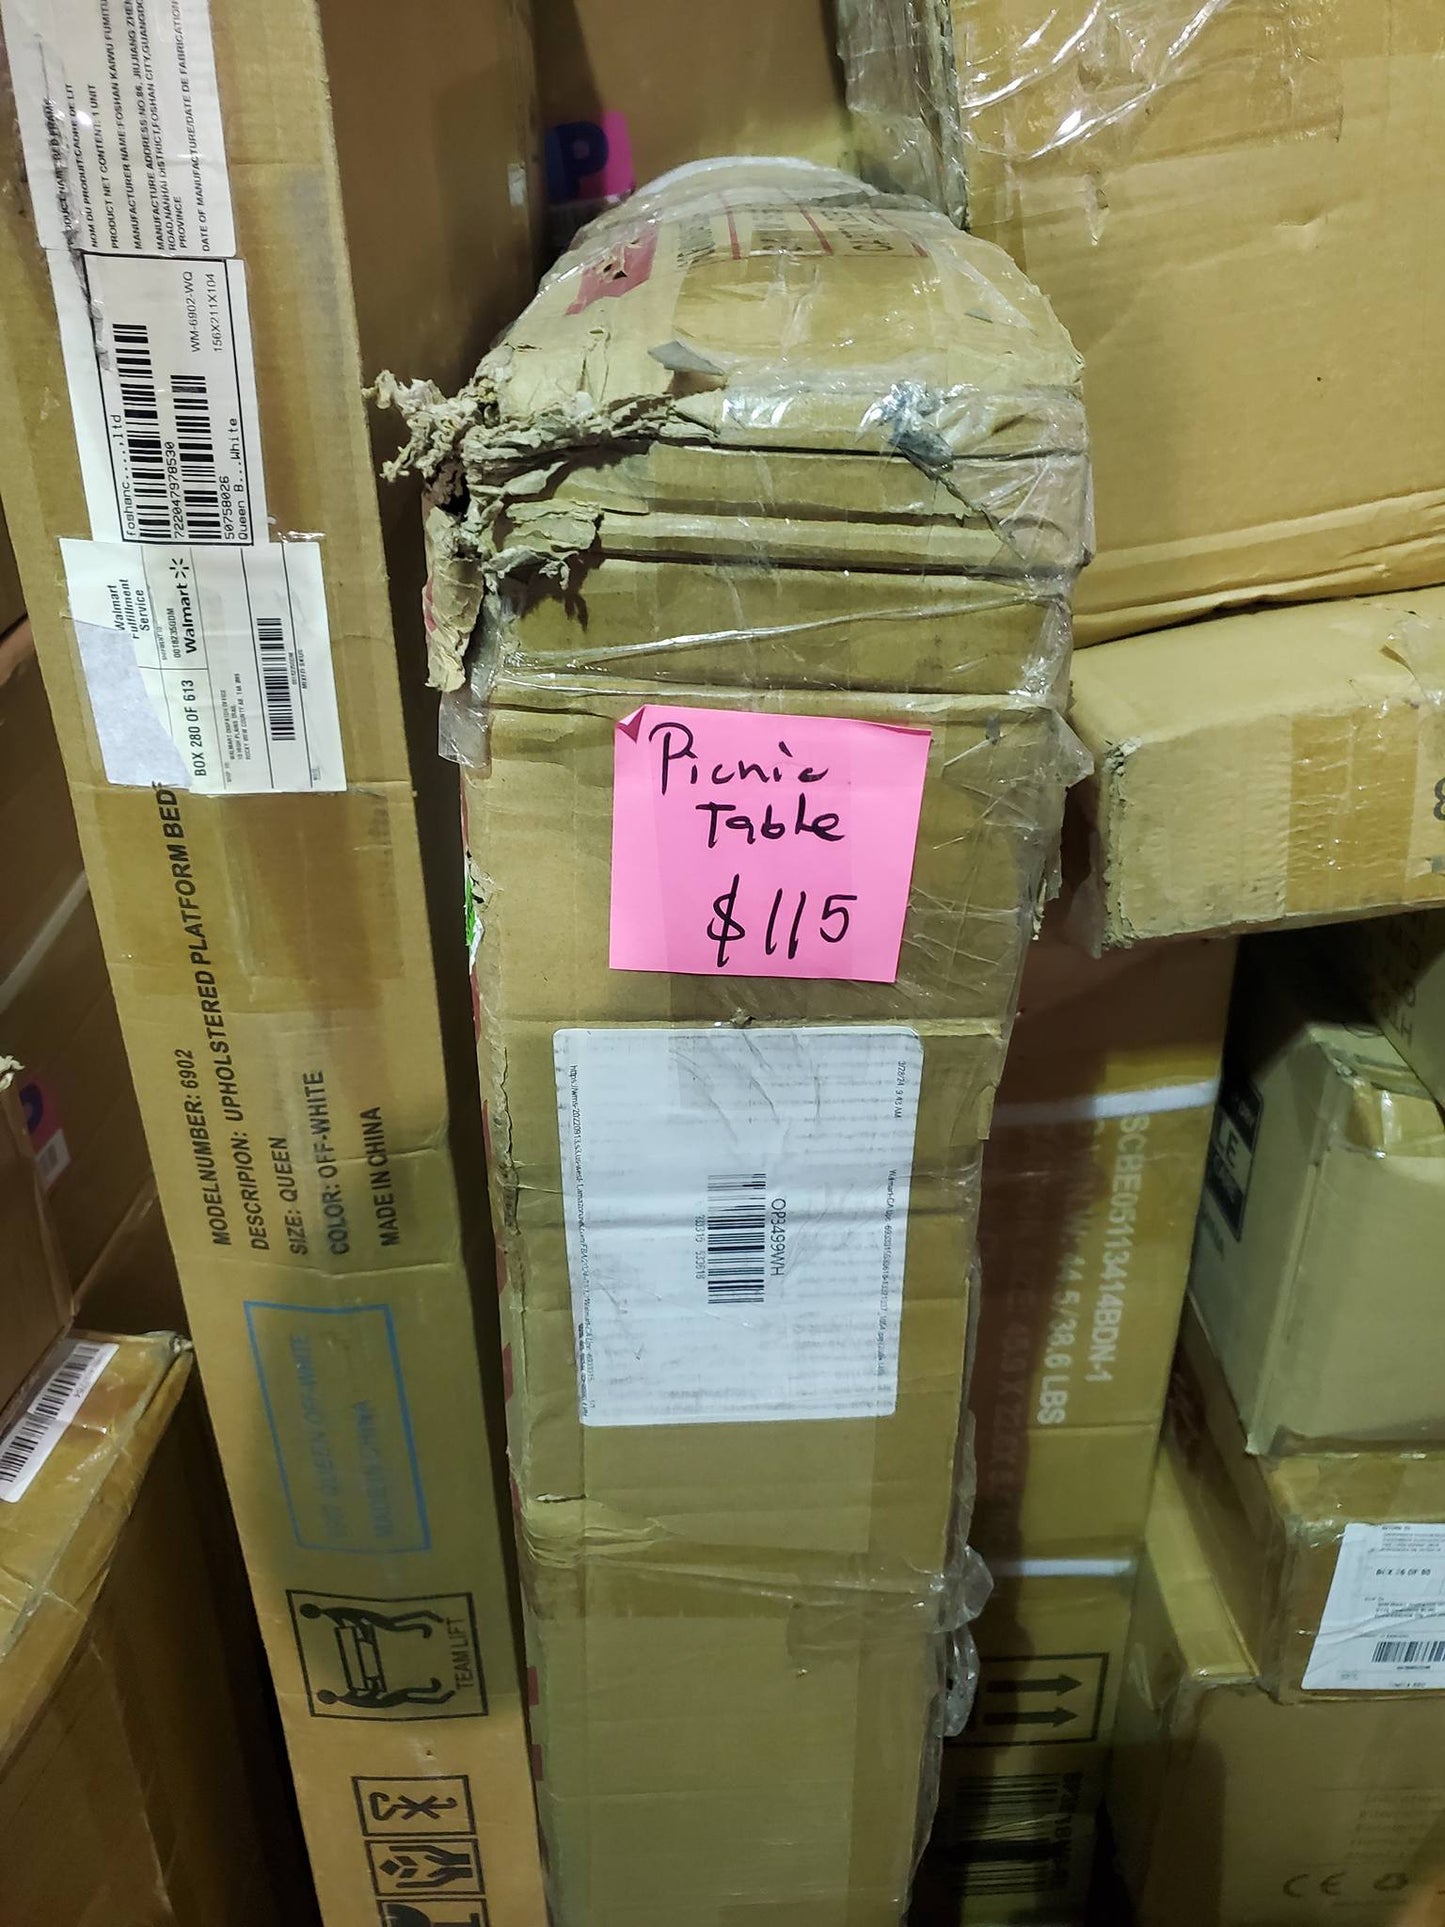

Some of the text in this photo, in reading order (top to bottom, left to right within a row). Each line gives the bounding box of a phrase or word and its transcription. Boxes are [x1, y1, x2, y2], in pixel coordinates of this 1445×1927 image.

[106, 43, 119, 79] KAIWU
[128, 30, 142, 78] JIUJIANG
[180, 77, 190, 92] DE
[87, 84, 98, 108] UNIT
[100, 176, 111, 196] NET
[182, 95, 204, 206] MANUFACTURE/DATE
[83, 207, 93, 221] DU
[86, 224, 97, 247] NOM
[104, 199, 119, 248] PRODUCT
[122, 163, 142, 249] MANUFACTURER
[147, 172, 164, 250] MANUFACTURE
[173, 195, 187, 248] PROVINCE
[196, 209, 206, 222] OF
[198, 225, 210, 251] DATE
[181, 271, 201, 352] WM-6902-WQ
[207, 273, 223, 353] 156X211X104
[164, 441, 185, 539] 722047978530
[218, 476, 236, 540] 50758026
[236, 500, 249, 541] Queen
[107, 585, 125, 631] Walmart
[134, 589, 150, 631] Service
[176, 583, 197, 654] Walmart
[181, 679, 208, 776] BOX 280 OF 613
[648, 722, 829, 796] Picnic
[157, 789, 188, 840] BED
[695, 793, 845, 849] Table
[169, 844, 215, 966] PLATFORM
[707, 873, 858, 968] $115
[194, 970, 244, 1123] UPHOLSTERED
[174, 1048, 232, 1247] MODELNUMBER: 6902
[302, 1069, 352, 1257] COLOR: OFF-WHITE
[359, 1106, 400, 1246] MADE IN CHINA
[231, 1130, 270, 1252] DESCRIPION:
[268, 1136, 310, 1258] SIZE: QUEEN
[770, 1198, 788, 1278] OP3499WH
[1036, 1374, 1070, 1427] LBS
[445, 1617, 475, 1690] TEAM LIFT
